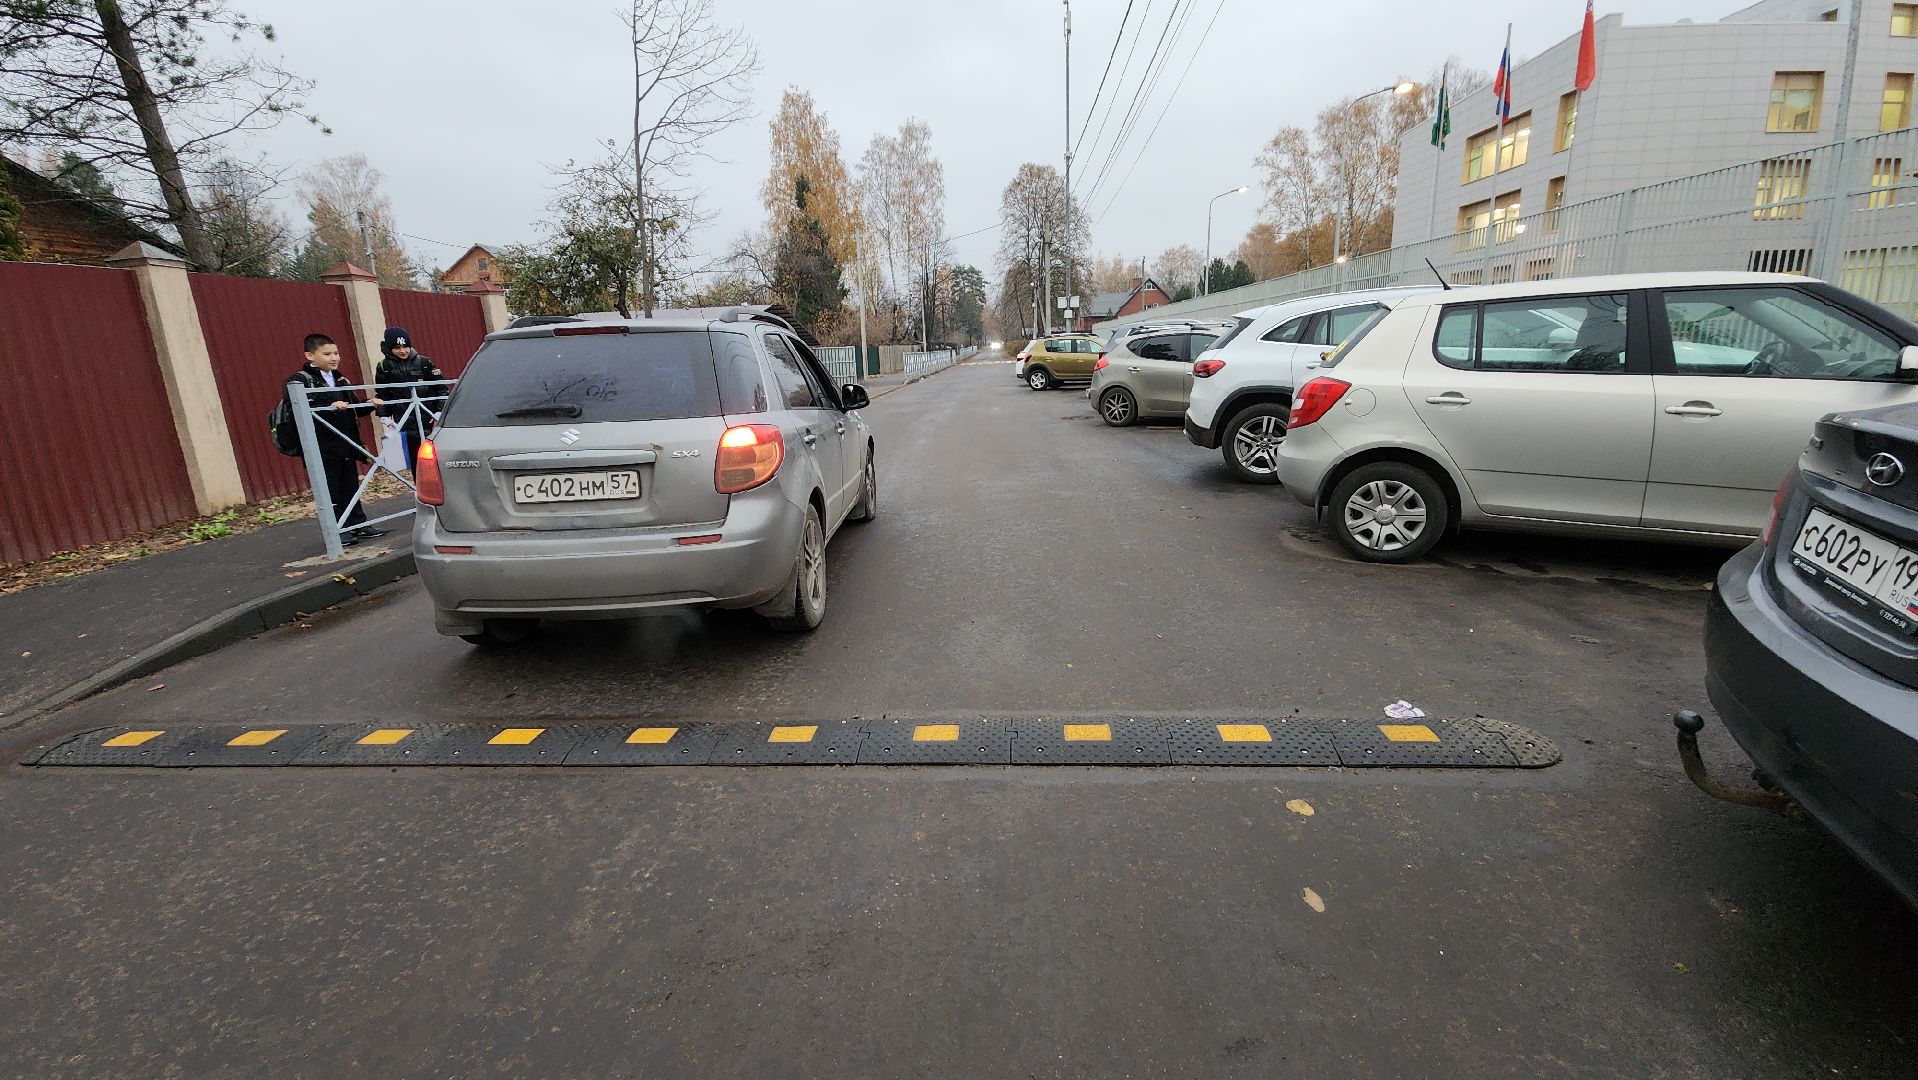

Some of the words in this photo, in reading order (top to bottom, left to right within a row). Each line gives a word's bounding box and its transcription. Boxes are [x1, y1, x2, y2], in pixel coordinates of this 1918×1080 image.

[672, 449, 700, 458] SX4
[445, 460, 480, 468] SUZUKI
[610, 474, 631, 490] 57
[1895, 554, 1918, 597] 19
[1888, 589, 1910, 608] RUS
